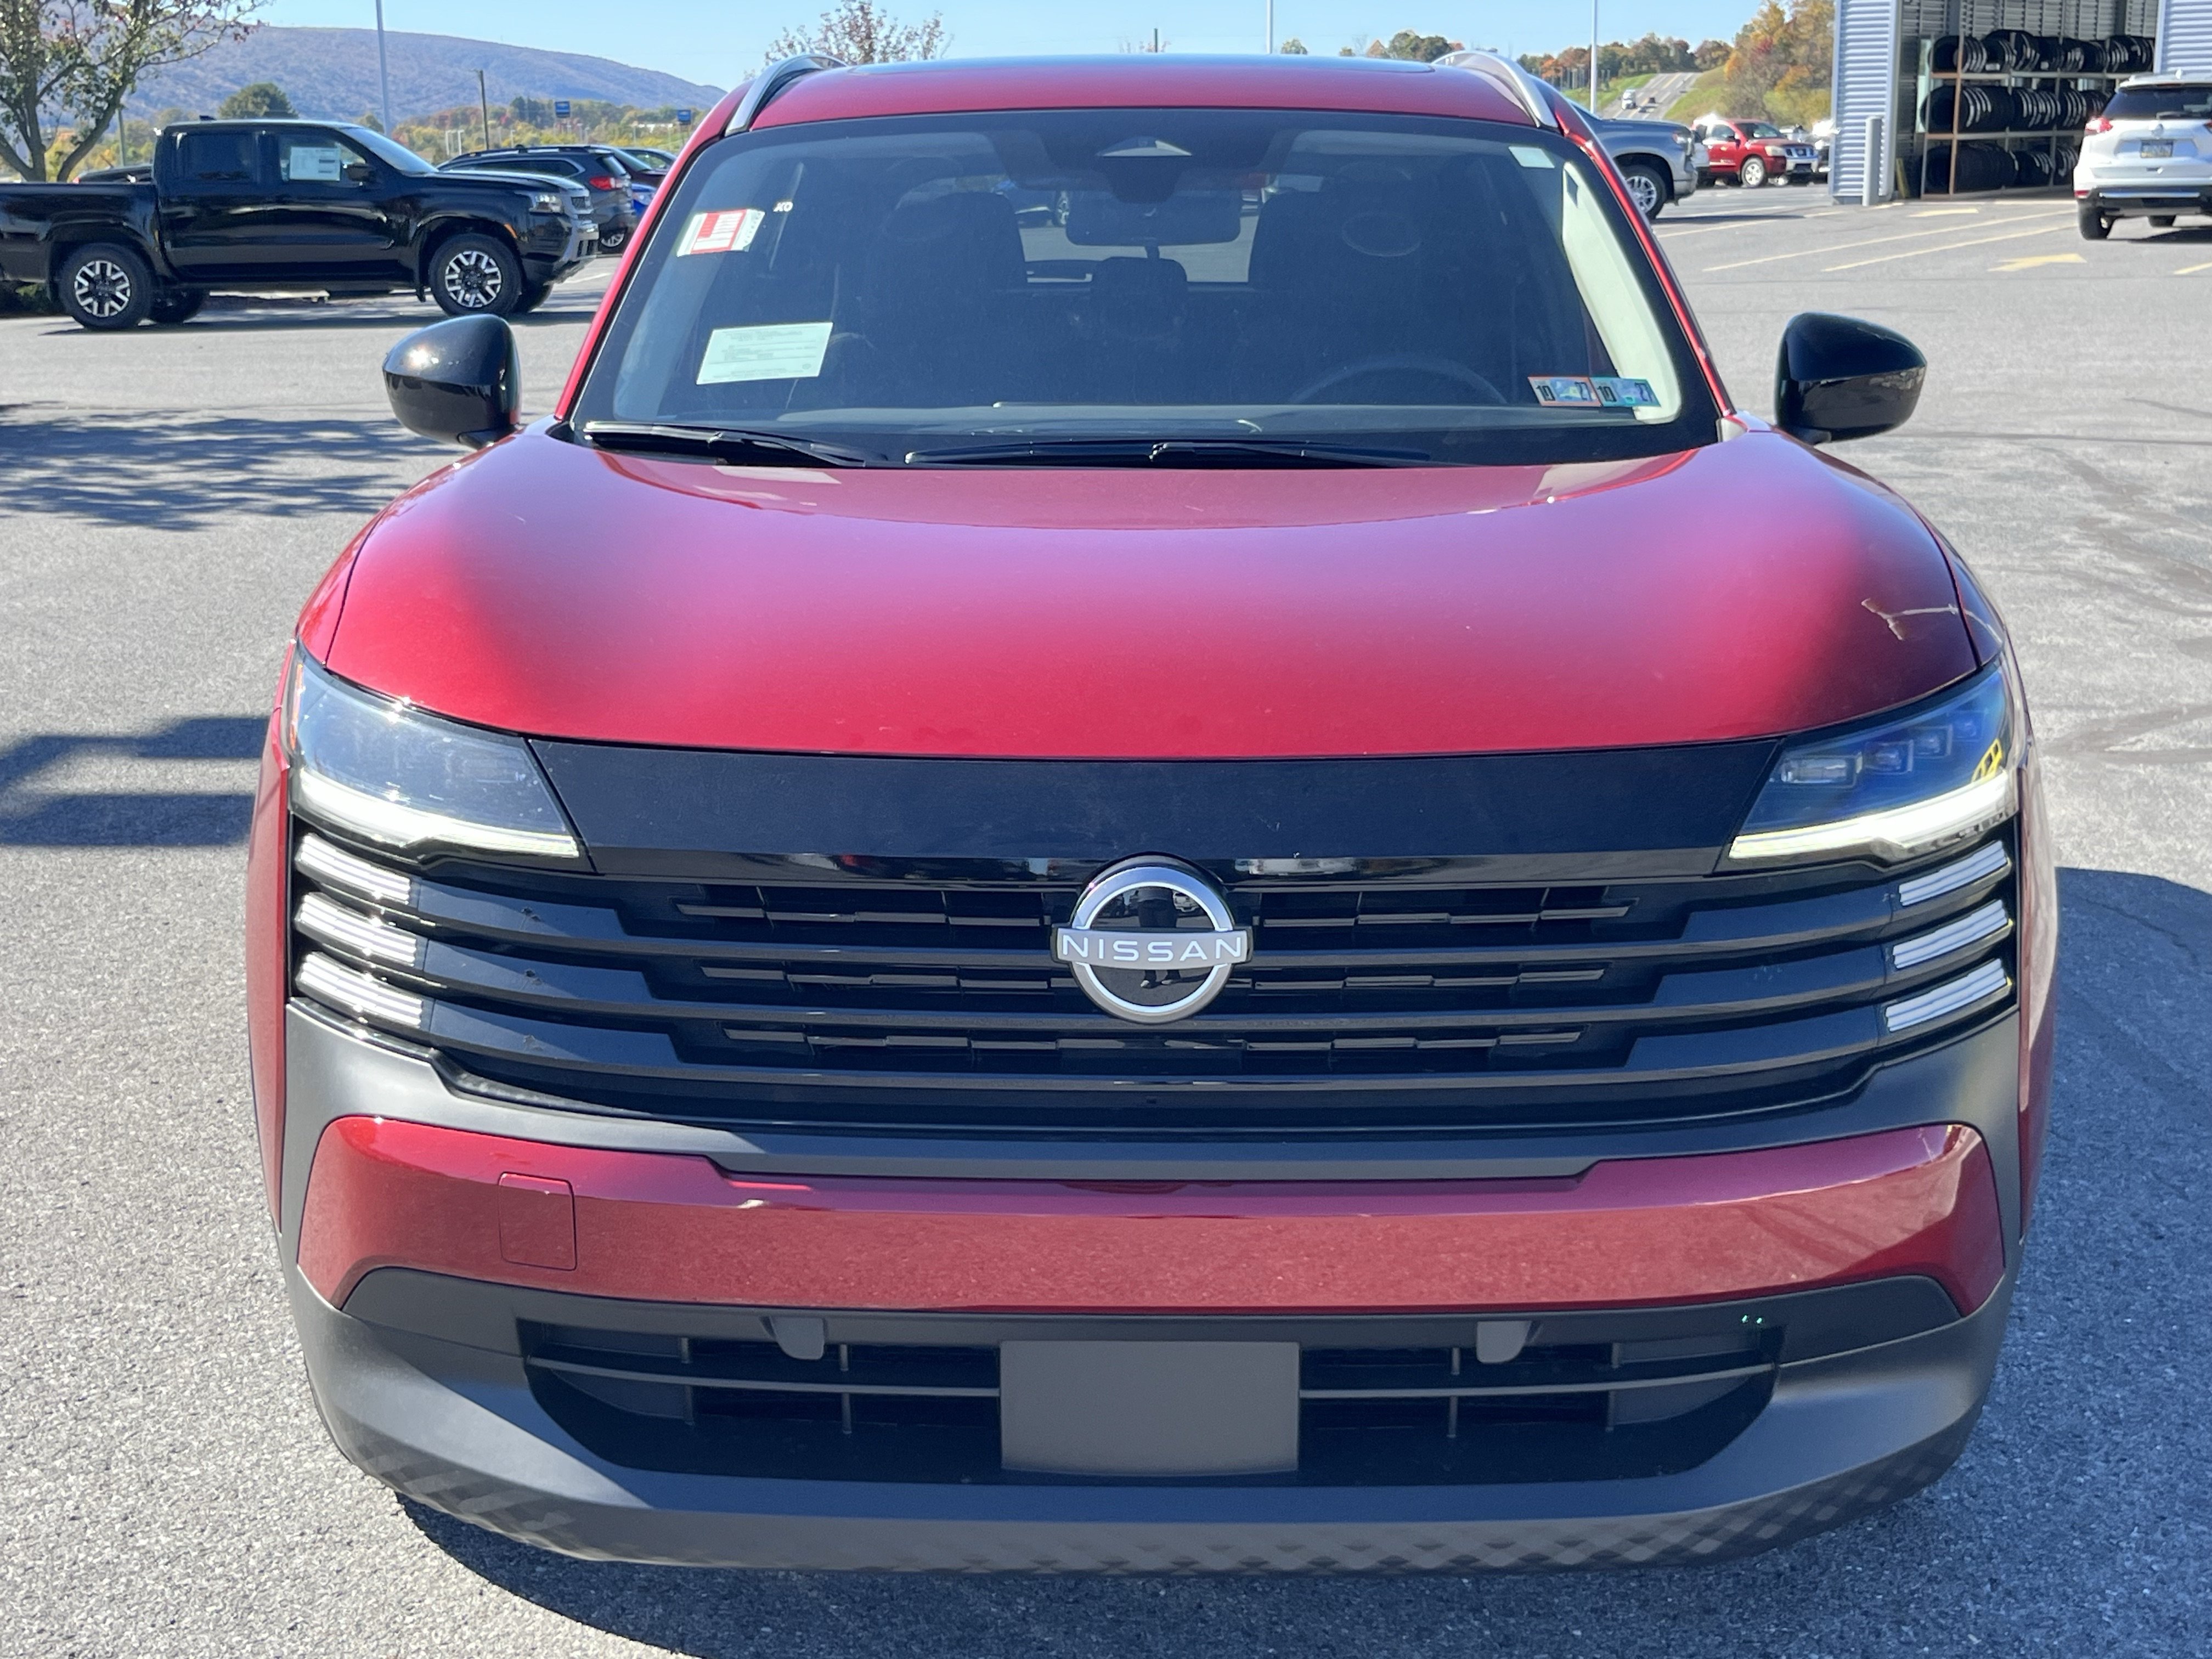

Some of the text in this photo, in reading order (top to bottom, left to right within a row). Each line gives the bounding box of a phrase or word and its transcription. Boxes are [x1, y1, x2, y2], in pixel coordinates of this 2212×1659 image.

[1536, 385, 1555, 401] 10
[1597, 386, 1617, 402] 10
[1062, 934, 1242, 962] NISSAN
